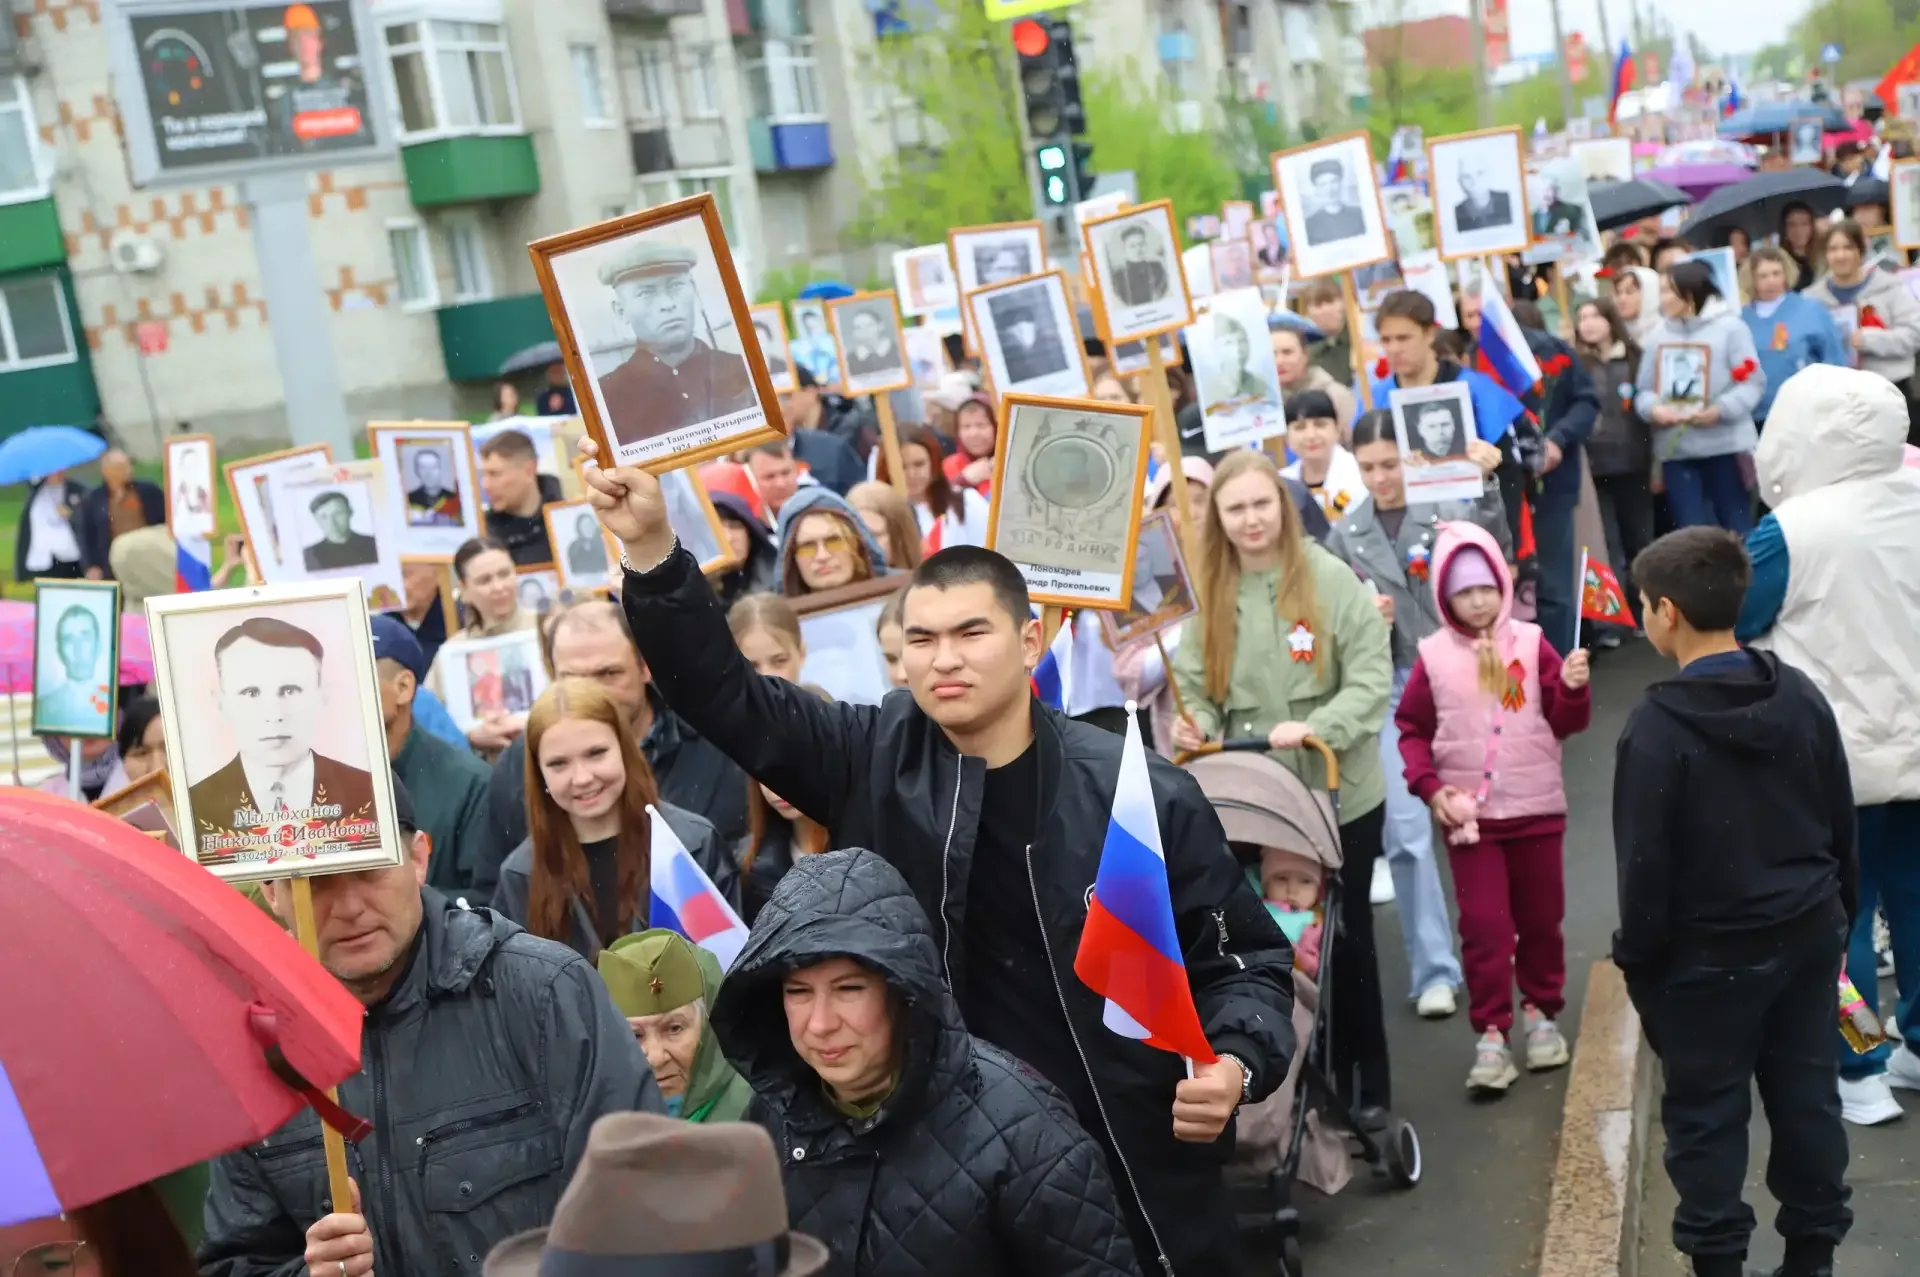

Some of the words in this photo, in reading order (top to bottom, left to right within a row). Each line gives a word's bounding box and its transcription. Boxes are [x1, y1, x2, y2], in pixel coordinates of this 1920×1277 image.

[621, 442, 664, 457] Махмутов
[666, 426, 712, 444] Таштимир
[714, 411, 762, 430] Катырович
[1044, 537, 1109, 556] РОДИНУ
[1030, 564, 1082, 577] Пономарев
[1024, 578, 1049, 588] андр
[1051, 579, 1111, 592] Прокопьевич
[235, 804, 342, 827] Милюханов
[202, 830, 284, 850] Николай
[291, 821, 380, 840] Иванович
